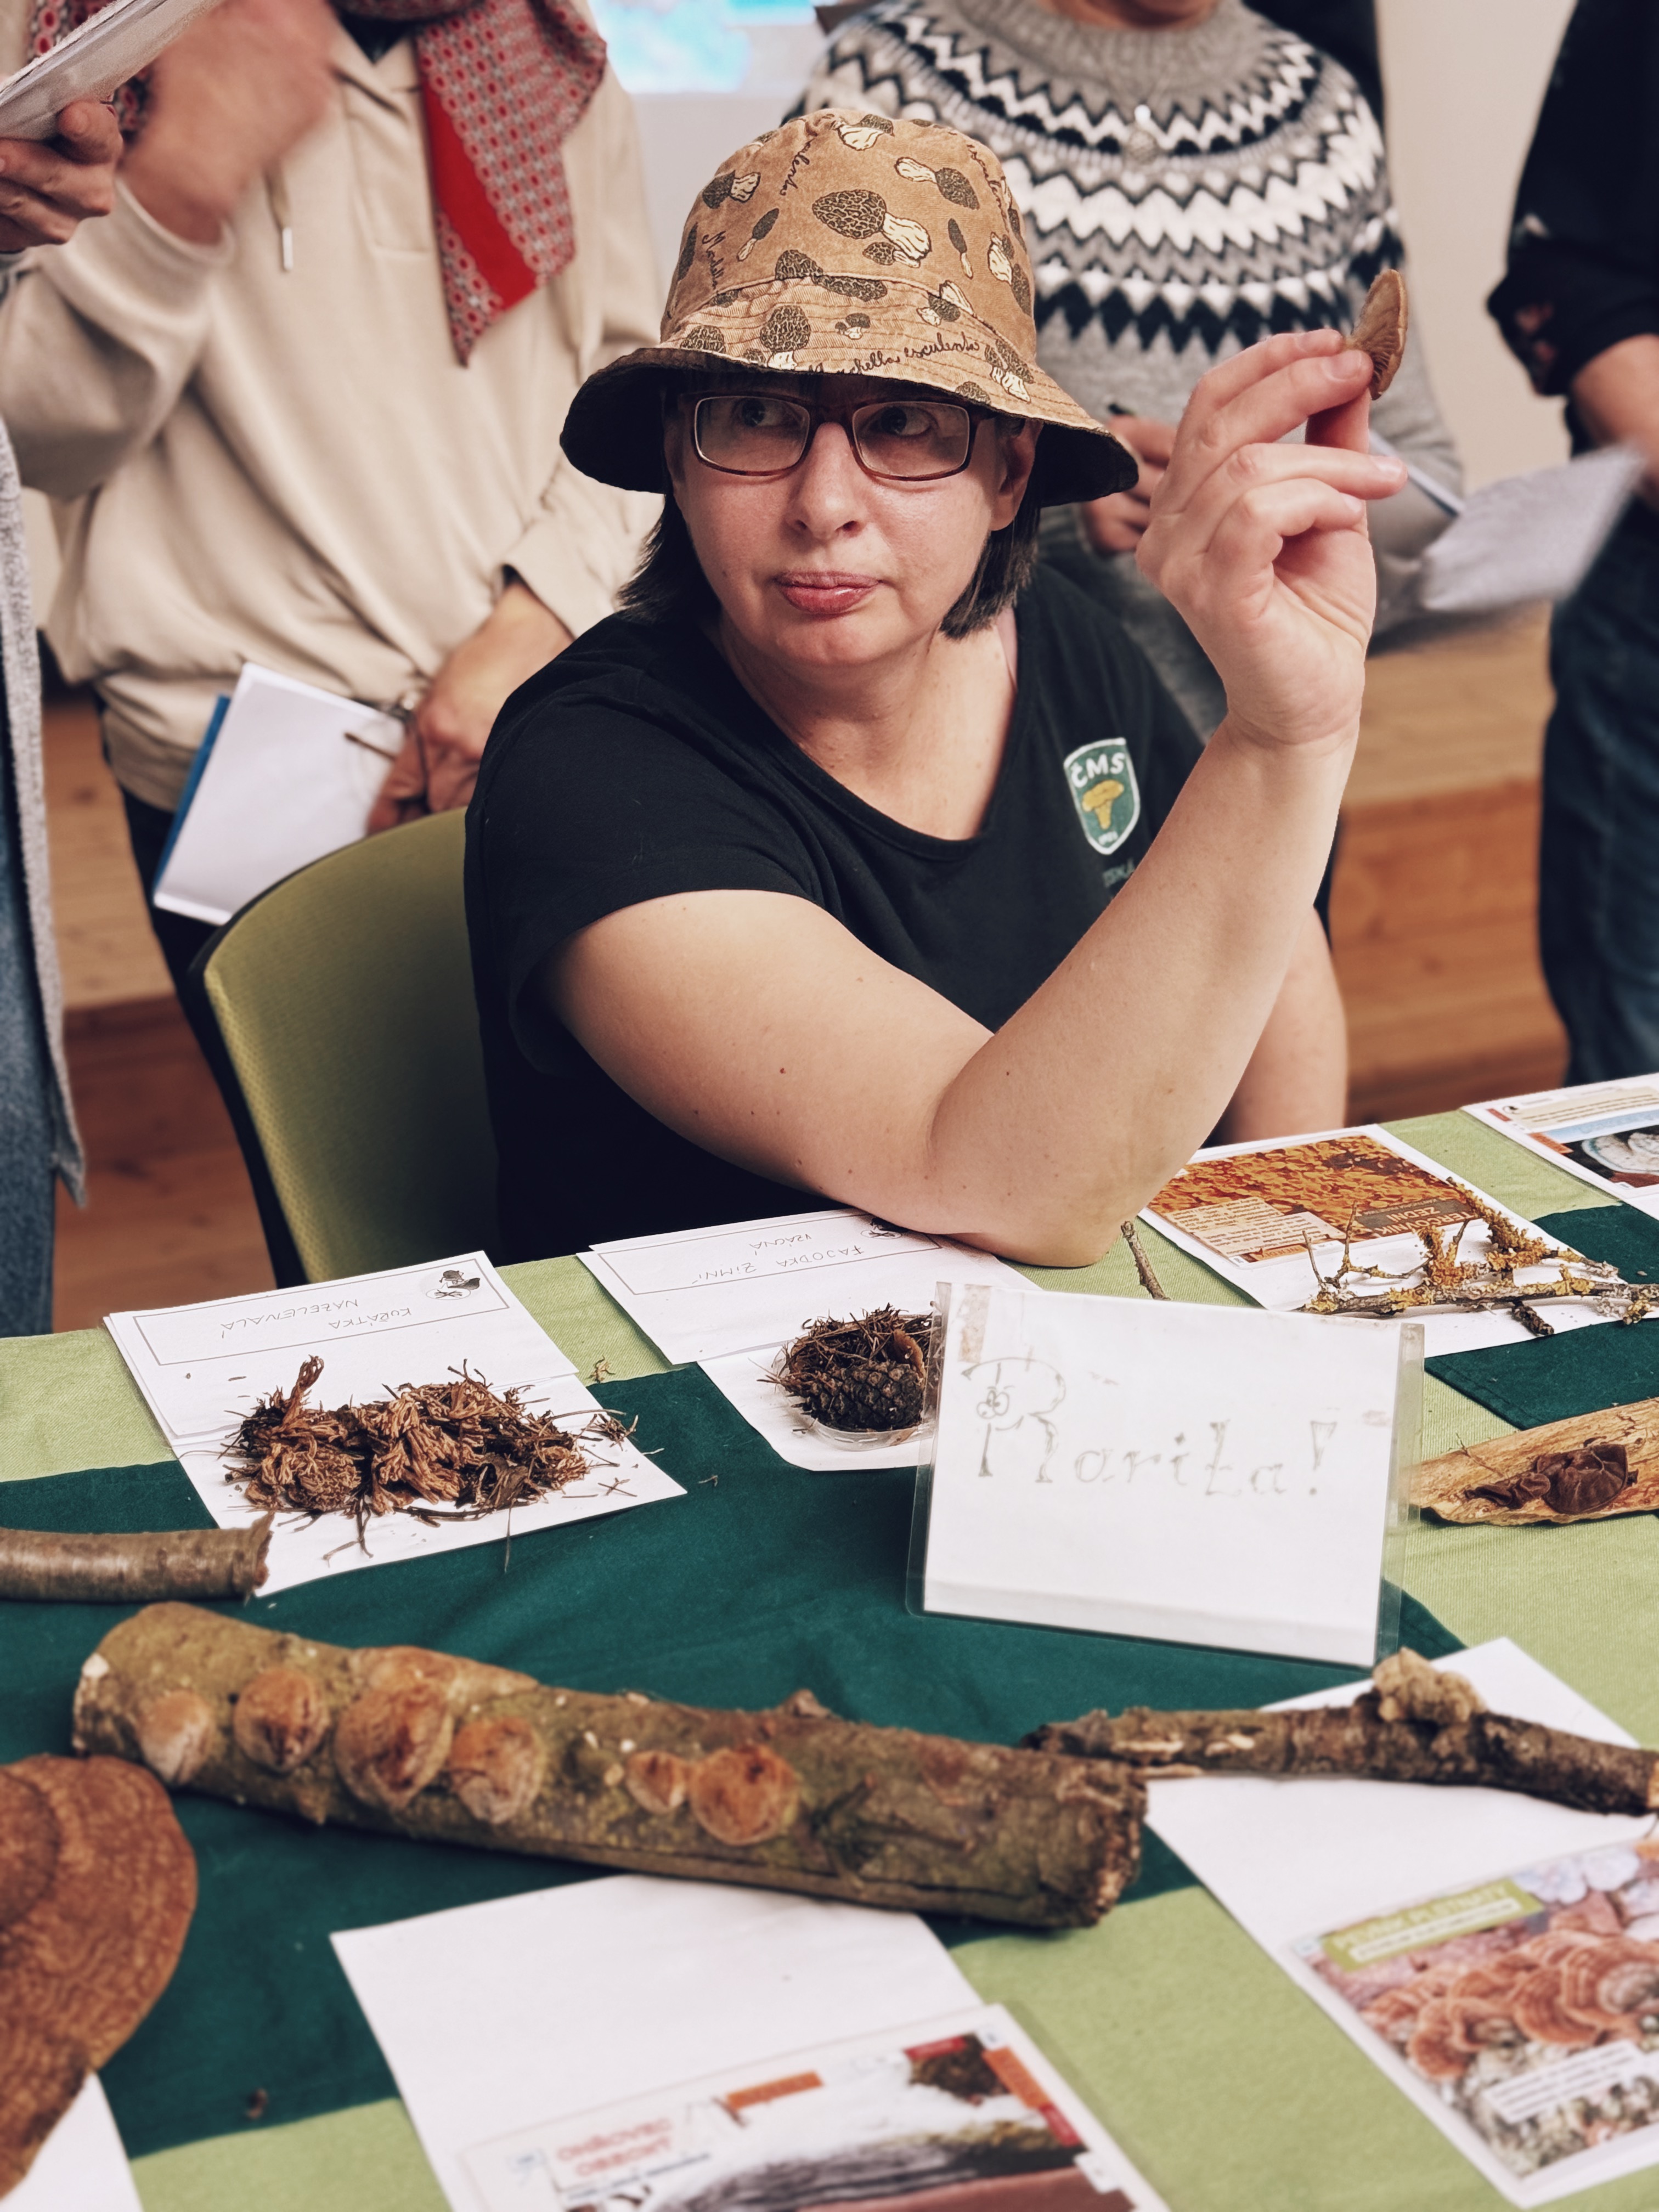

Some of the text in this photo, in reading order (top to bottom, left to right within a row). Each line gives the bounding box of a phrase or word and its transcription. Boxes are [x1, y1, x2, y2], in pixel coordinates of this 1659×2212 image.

[904, 331, 980, 358] esculenta
[1386, 1207, 1440, 1223] ZEDNÍ
[329, 1307, 411, 1329] KUŘÁTKA
